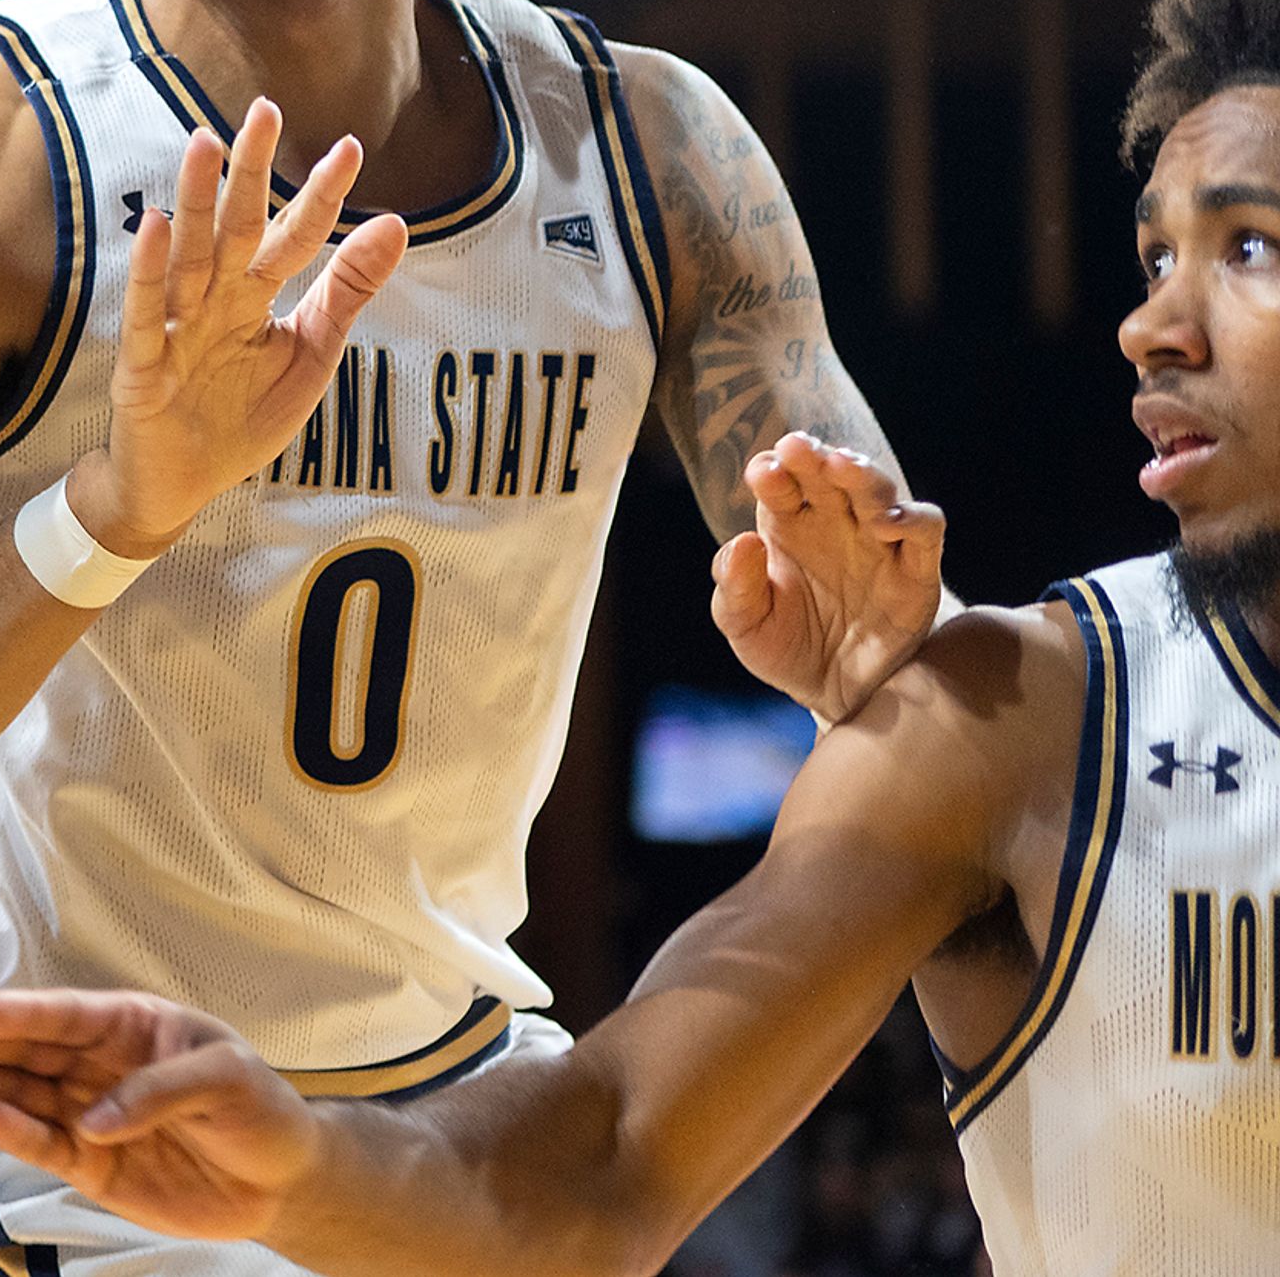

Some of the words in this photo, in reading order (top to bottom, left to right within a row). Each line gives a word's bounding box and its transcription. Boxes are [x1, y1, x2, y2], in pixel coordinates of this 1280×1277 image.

[719, 272, 772, 319] the
[426, 346, 597, 499] STATE
[282, 536, 424, 796] 0
